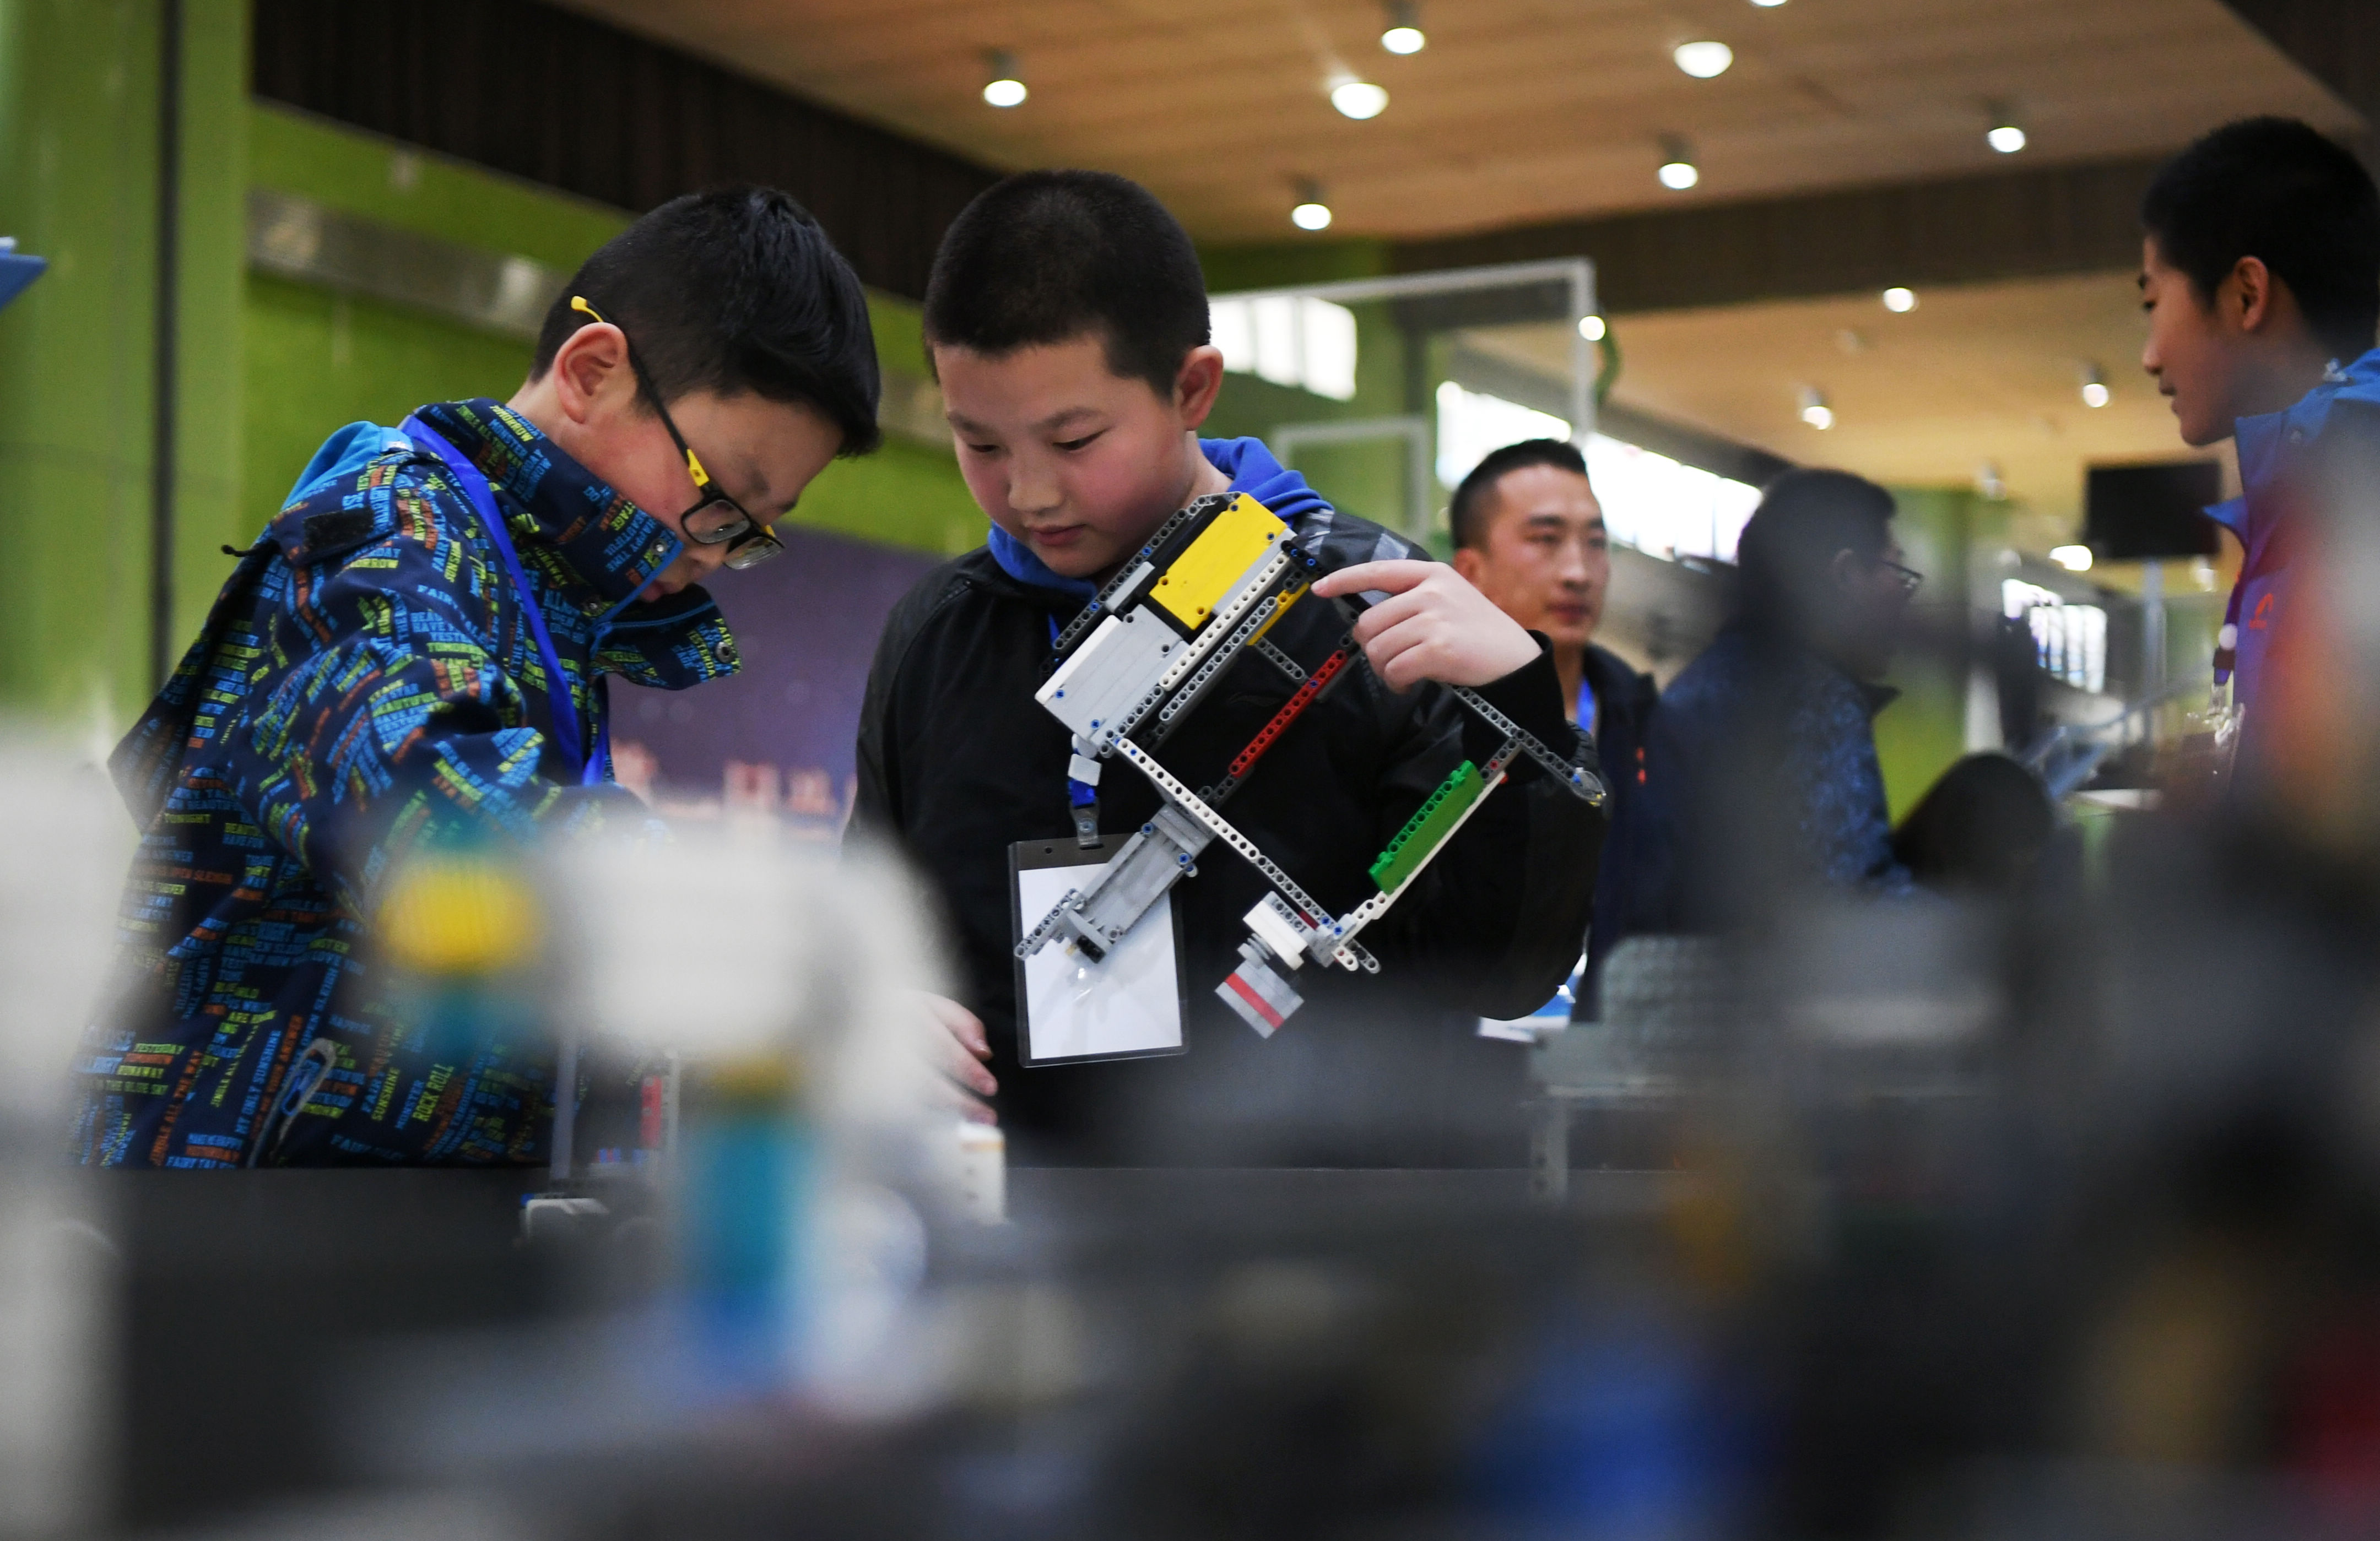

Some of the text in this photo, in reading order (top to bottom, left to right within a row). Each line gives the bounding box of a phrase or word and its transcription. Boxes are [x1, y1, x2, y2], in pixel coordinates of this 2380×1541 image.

[489, 405, 533, 442] TOMORROW
[489, 419, 528, 459] MONSTER
[631, 517, 658, 552] HAPPY
[235, 1030, 283, 1135] MY ONLY SUNSHINE
[371, 1067, 401, 1121] SUNSHINE
[394, 1079, 425, 1130] MONSTER
[412, 1062, 456, 1122] ROCK ROLL
